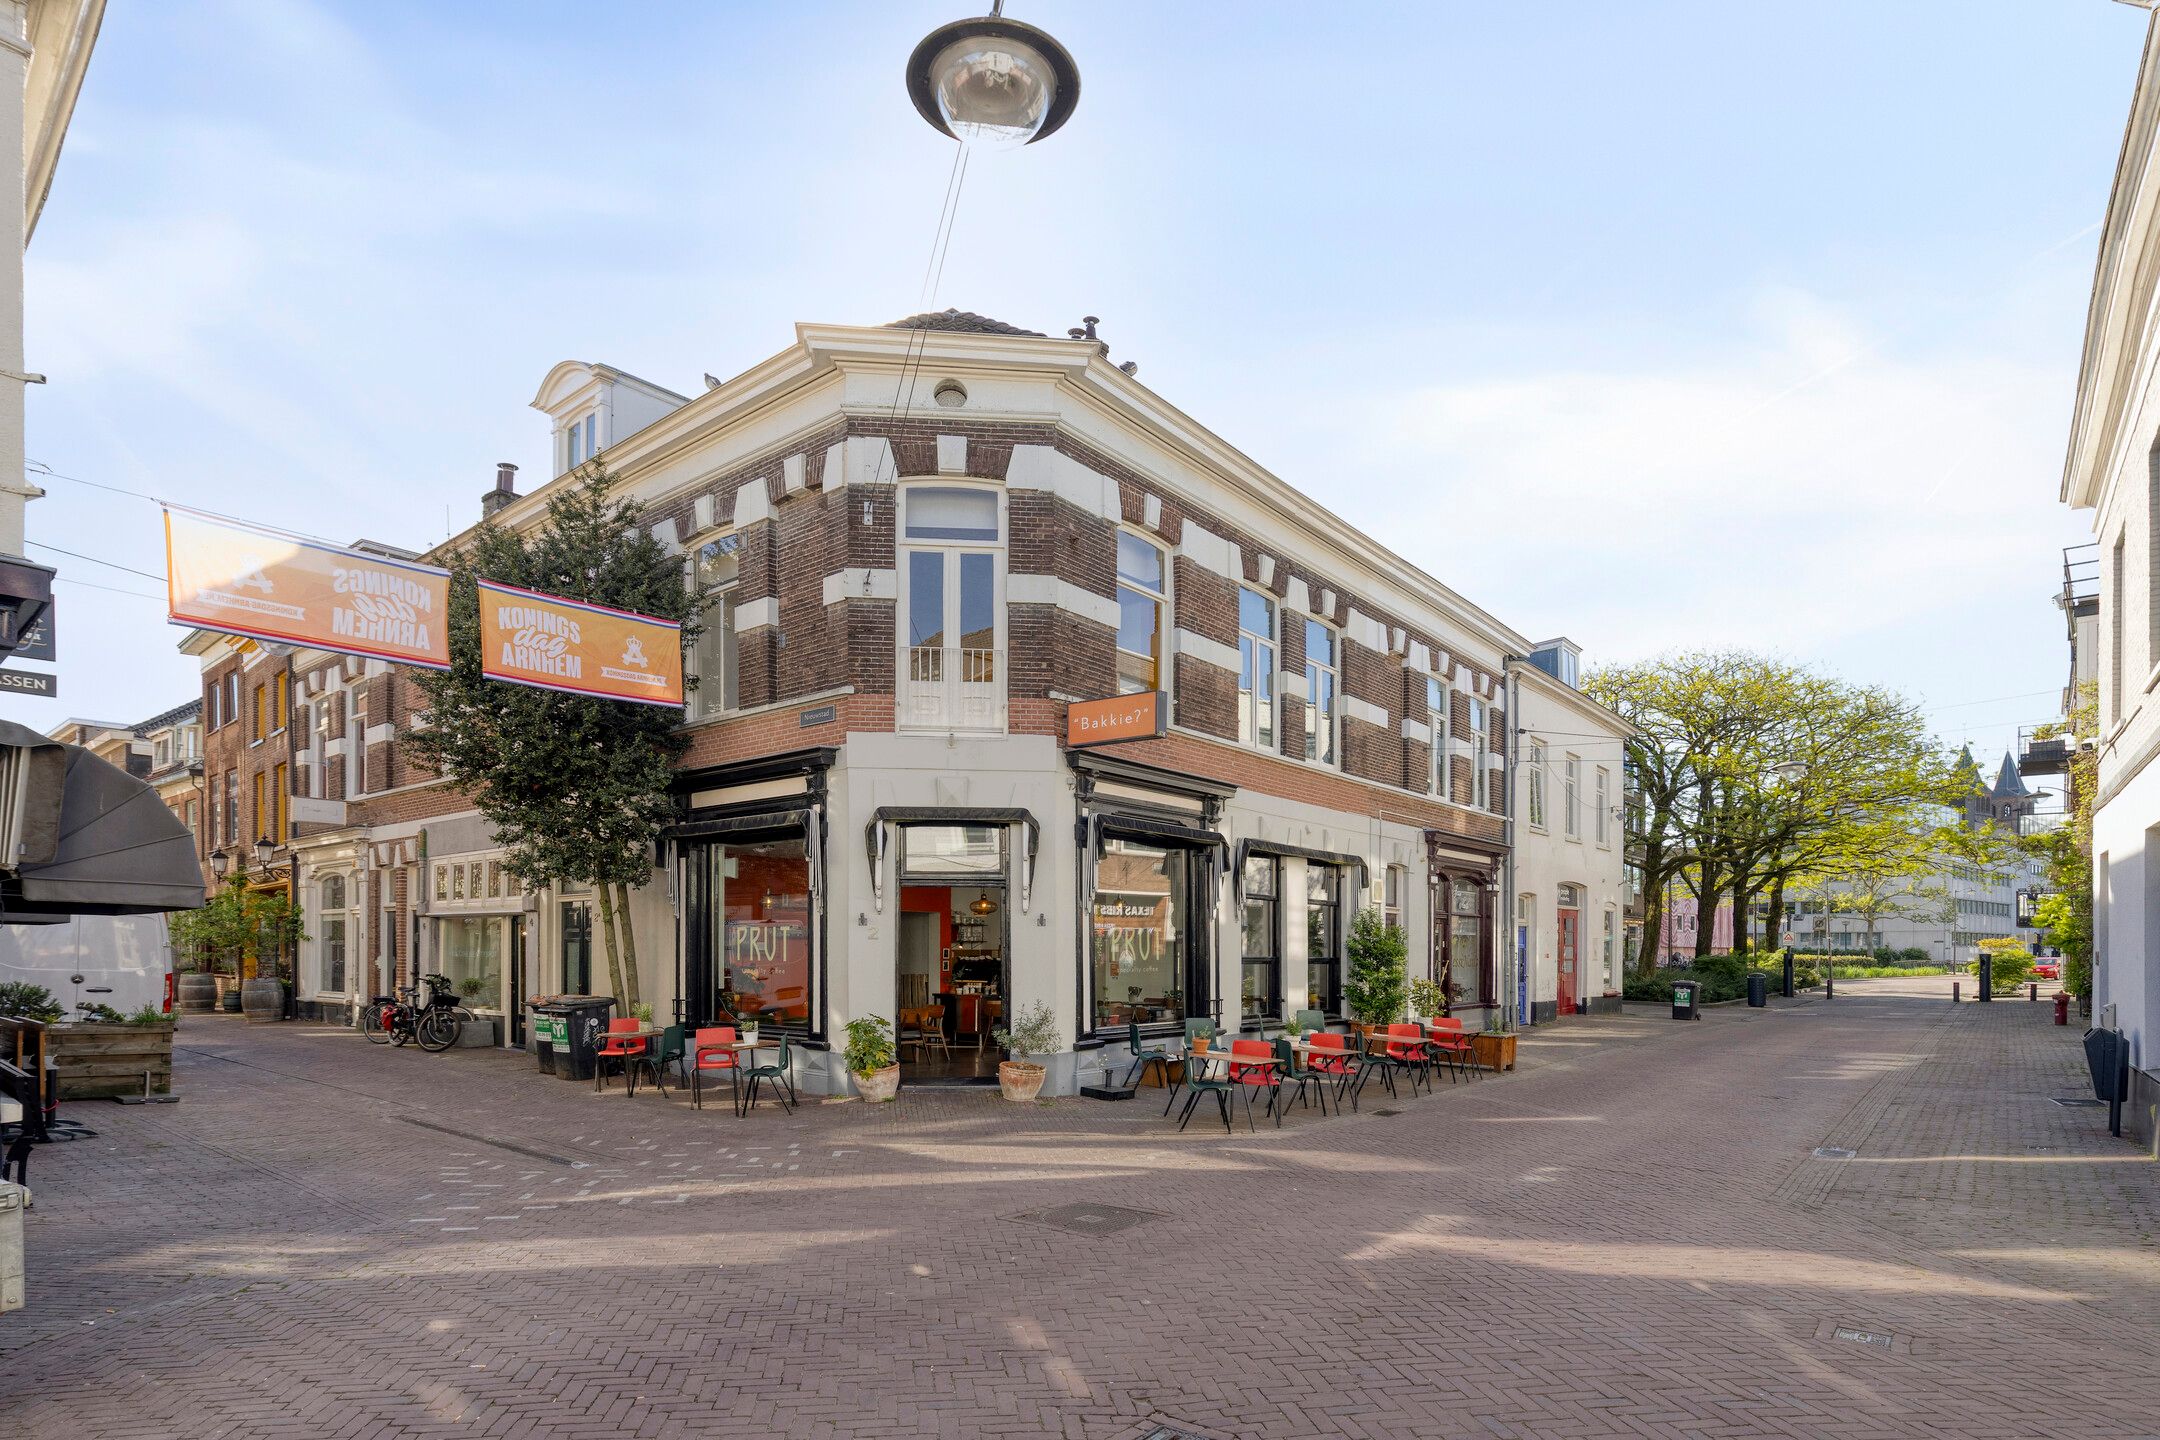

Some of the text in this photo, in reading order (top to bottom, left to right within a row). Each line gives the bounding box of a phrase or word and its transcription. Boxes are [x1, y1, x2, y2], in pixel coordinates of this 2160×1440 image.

[498, 606, 581, 645] KONINGS
[512, 625, 570, 658] dag
[501, 642, 582, 680] ARNHEM
[736, 926, 790, 962] PRUT
[1111, 927, 1162, 961] PRUT
